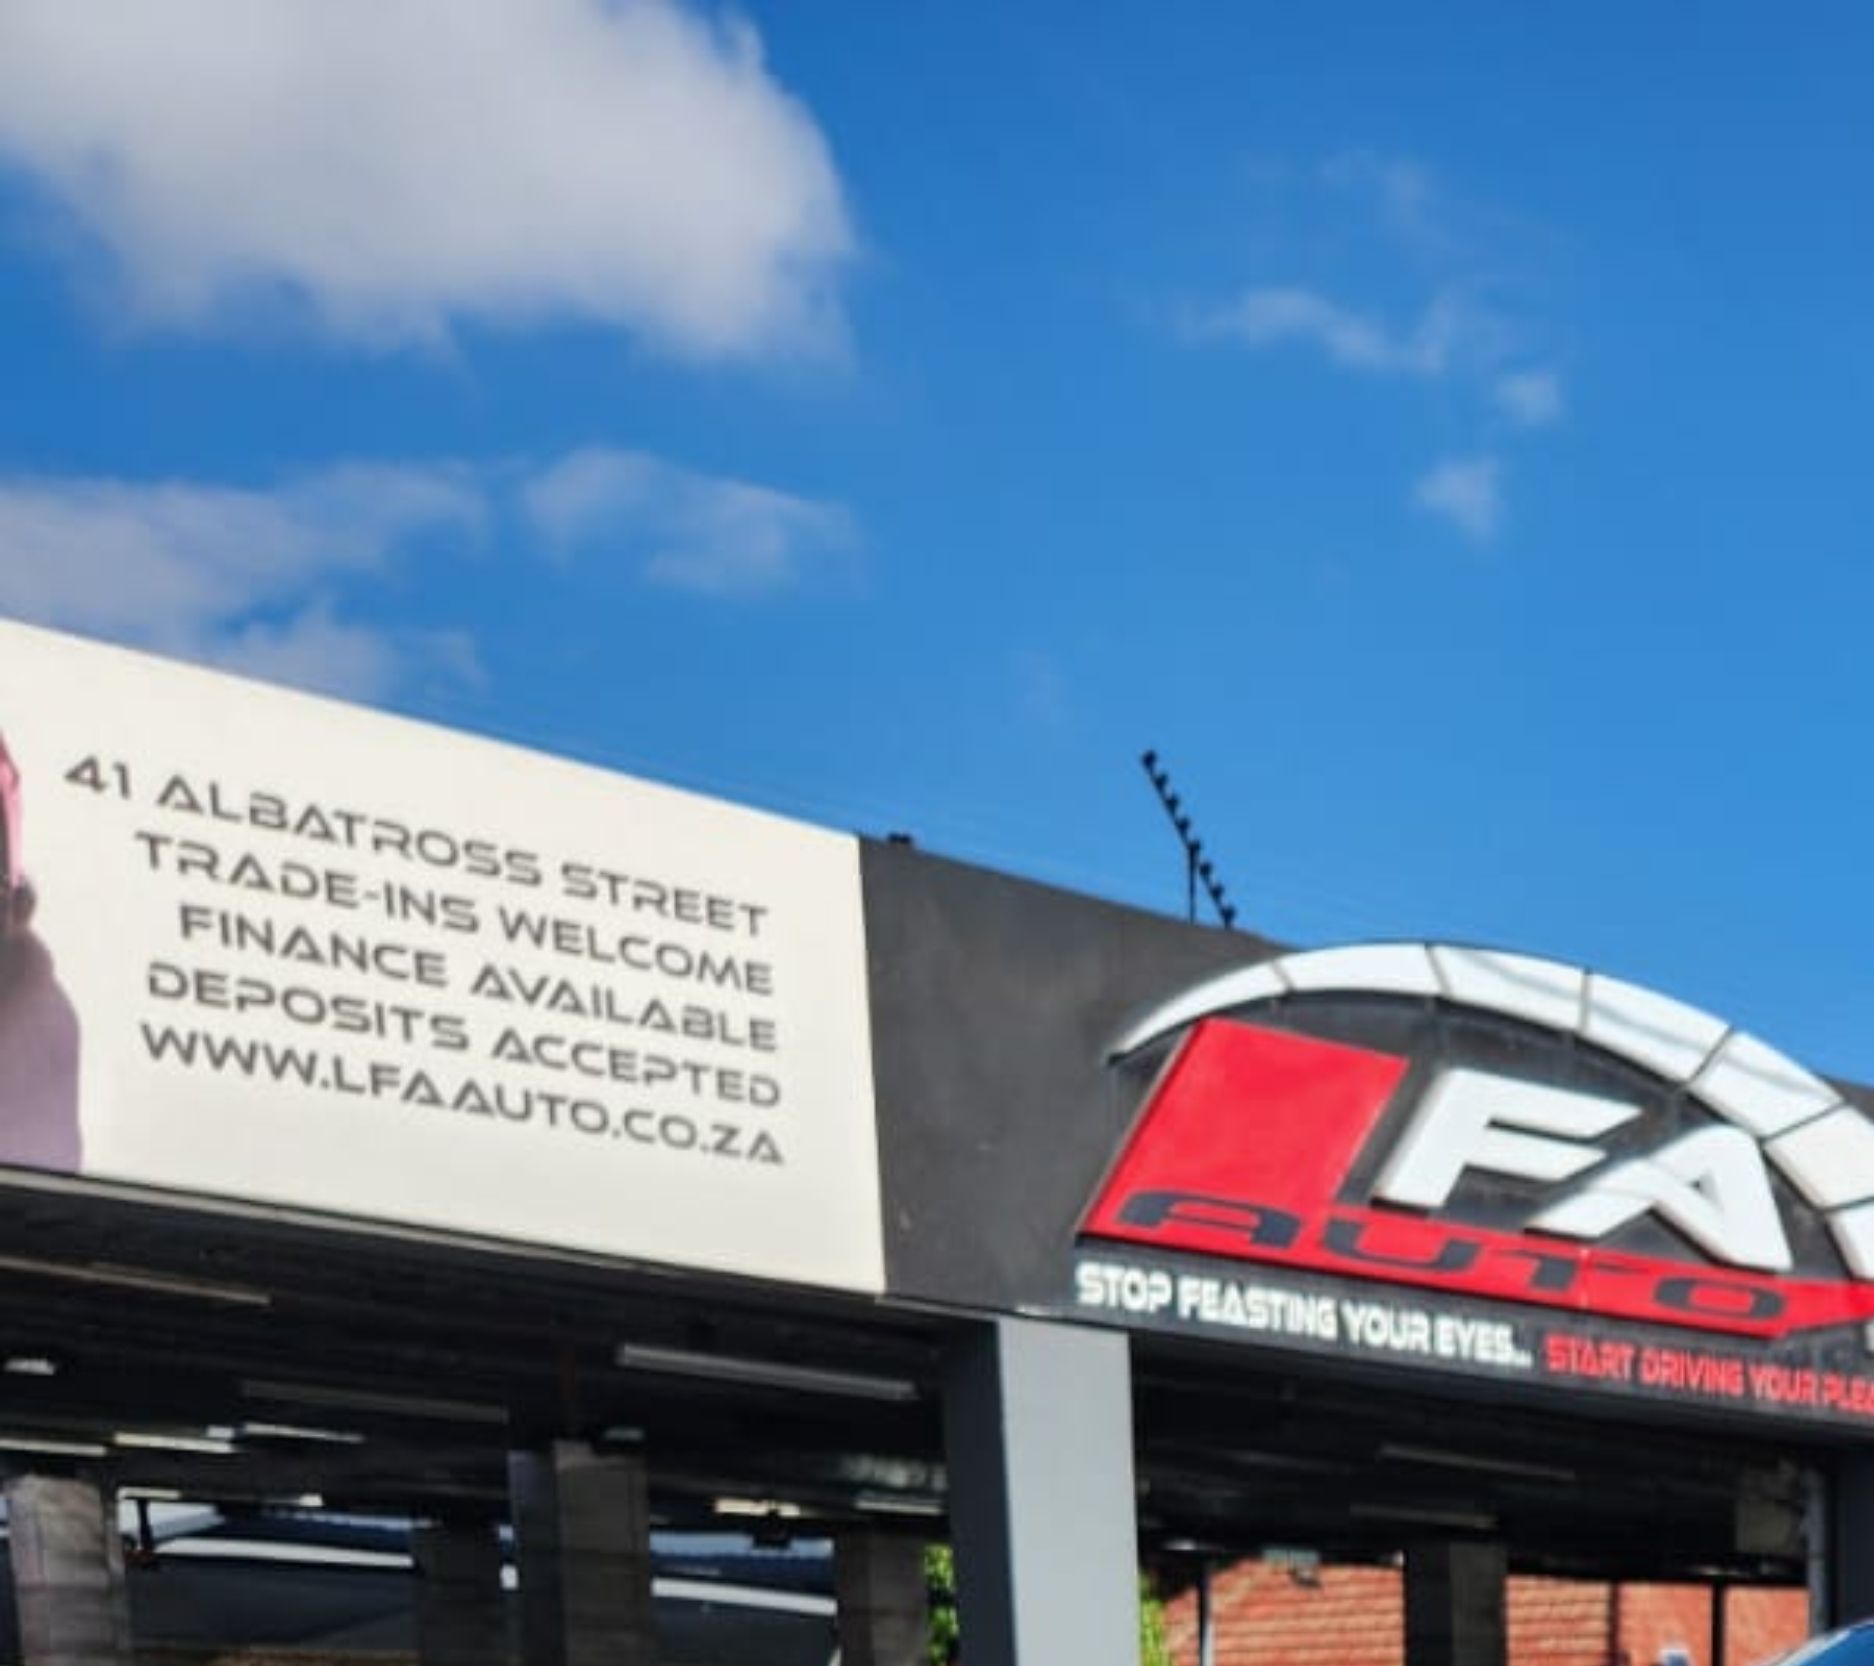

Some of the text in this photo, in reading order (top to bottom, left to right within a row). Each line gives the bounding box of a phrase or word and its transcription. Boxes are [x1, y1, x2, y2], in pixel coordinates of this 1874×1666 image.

[63, 756, 770, 938] 41 ALBATROSS STREET
[134, 832, 774, 995] TRADE-INS WELCOME
[146, 962, 782, 1108] DEPOSITS ACCEPTED
[179, 904, 778, 1053] FINANCE AVAILABLE
[139, 1024, 785, 1166] WWW.LFAAUTO.CO.ZA
[1119, 1189, 1790, 1320] AUTO
[1074, 1261, 1173, 1314] STOP
[1176, 1276, 1339, 1340] FEASTING
[1341, 1299, 1430, 1352] YOUR
[1545, 1334, 1635, 1378] START
[1640, 1346, 1744, 1398] DRIVING
[1749, 1364, 1817, 1402] YOUR
